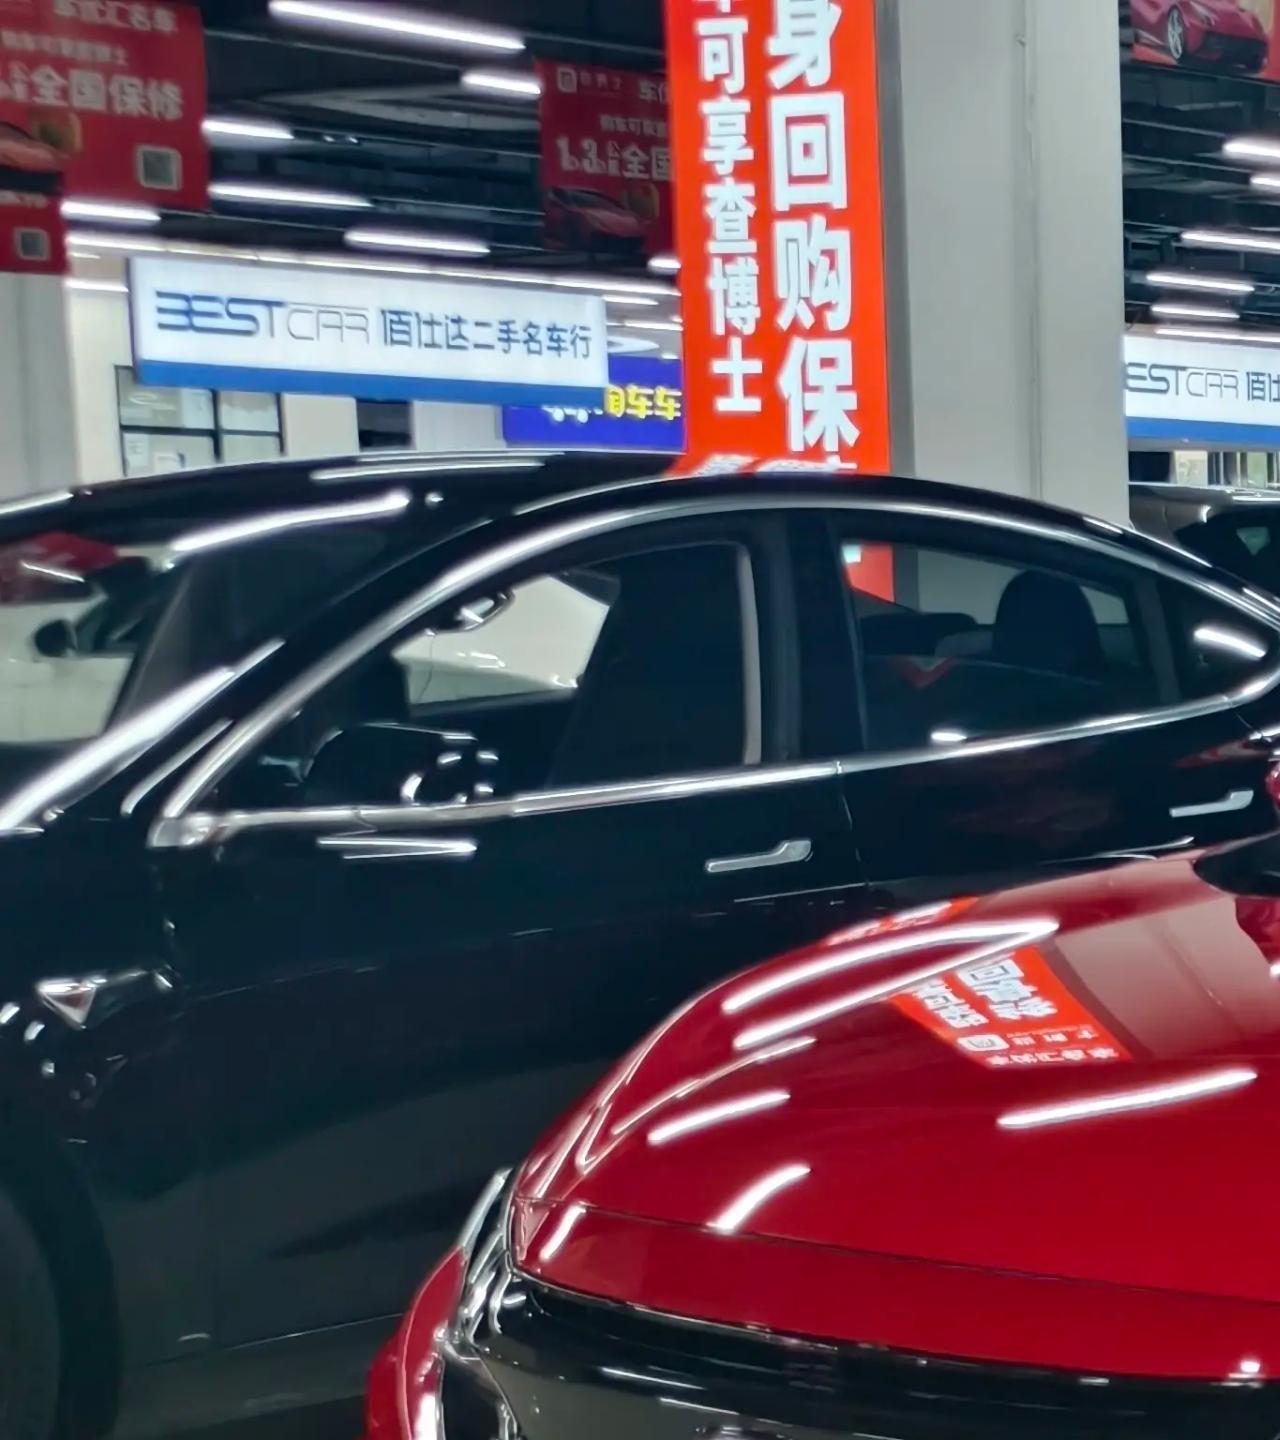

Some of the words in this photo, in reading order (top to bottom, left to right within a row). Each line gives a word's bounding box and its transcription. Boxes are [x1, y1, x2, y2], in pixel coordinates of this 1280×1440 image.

[378, 308, 592, 359] 佰仕达二手名车行
[695, 0, 764, 413] 可享查博士
[766, 0, 860, 472] 身回购保
